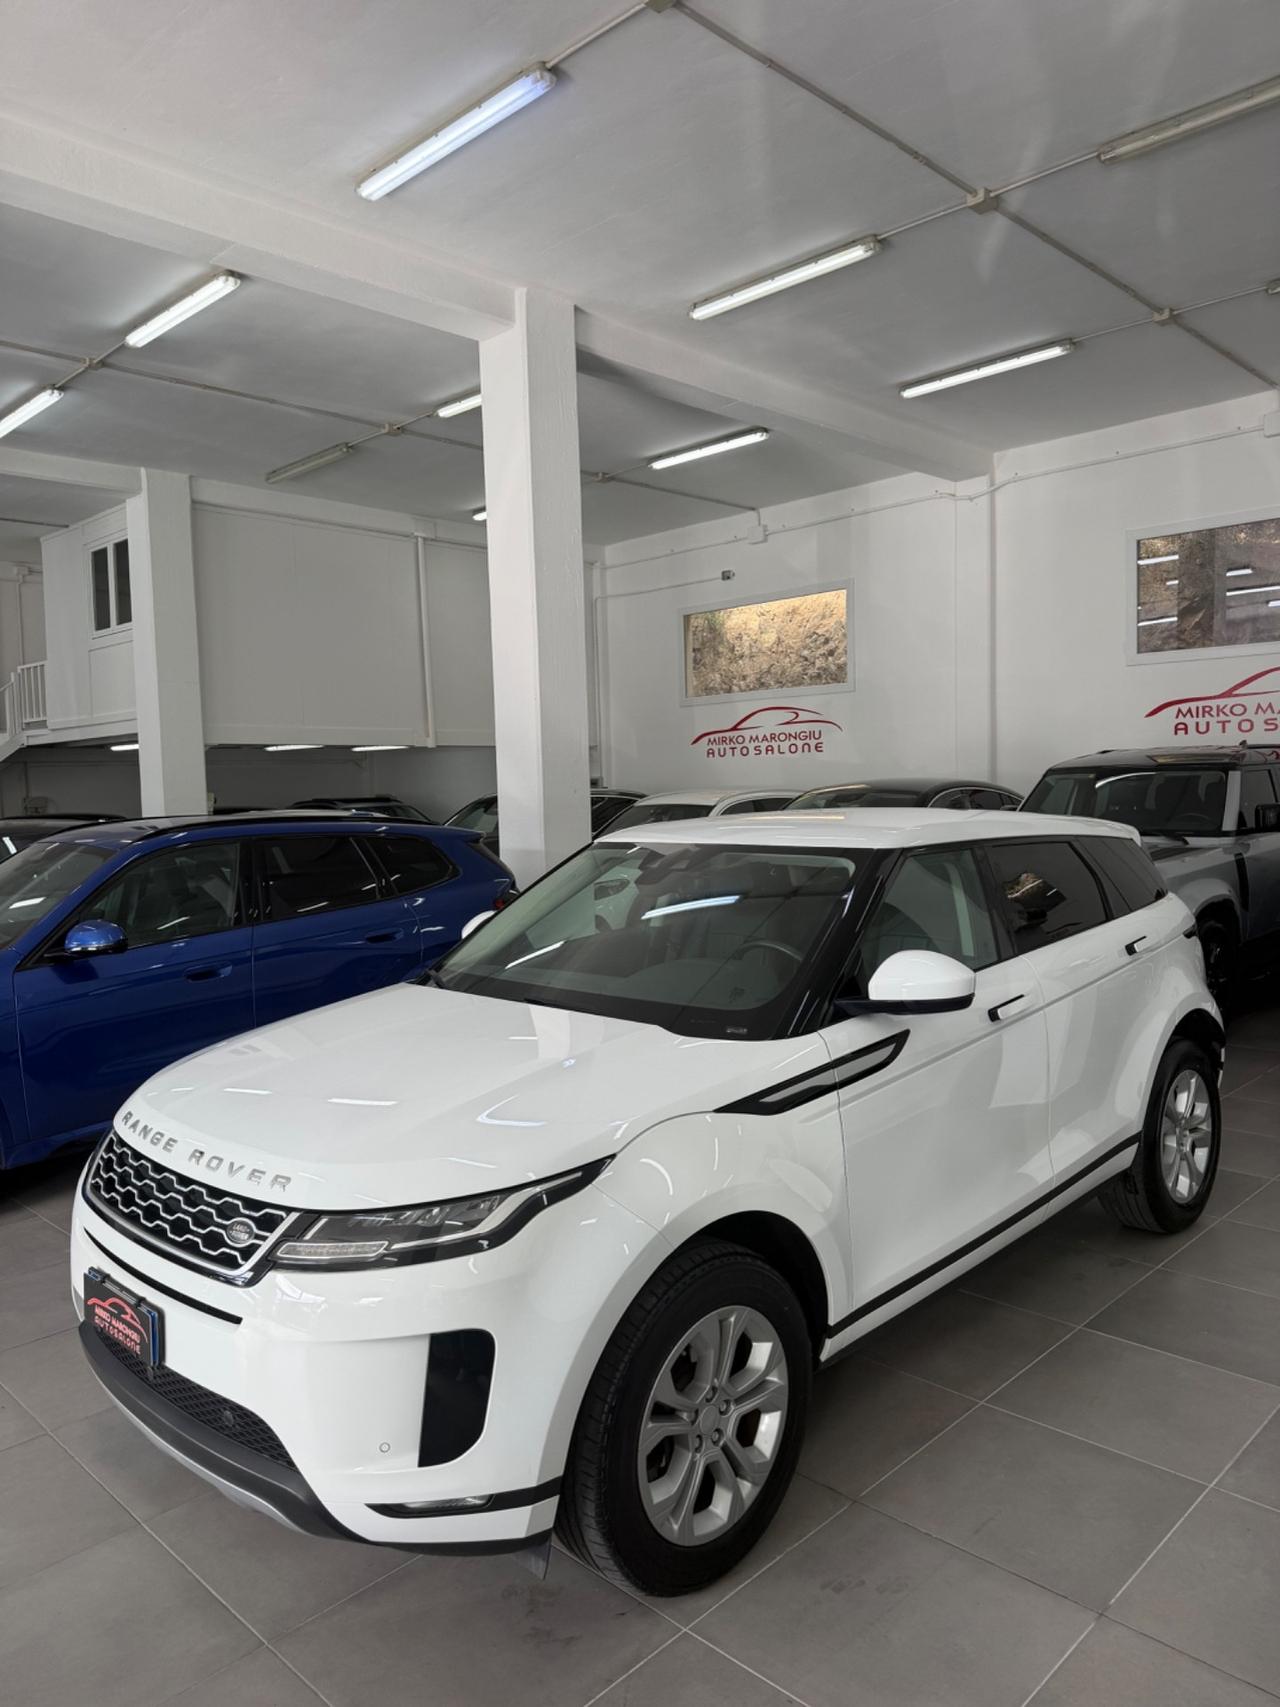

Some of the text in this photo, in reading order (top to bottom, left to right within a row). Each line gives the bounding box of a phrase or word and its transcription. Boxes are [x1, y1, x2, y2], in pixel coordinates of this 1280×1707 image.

[1175, 702, 1280, 719] MIRKO M
[707, 730, 822, 746] MIRKO MARONGIU
[706, 742, 824, 758] AUTOSALONE
[121, 1110, 292, 1193] RANGE ROVER
